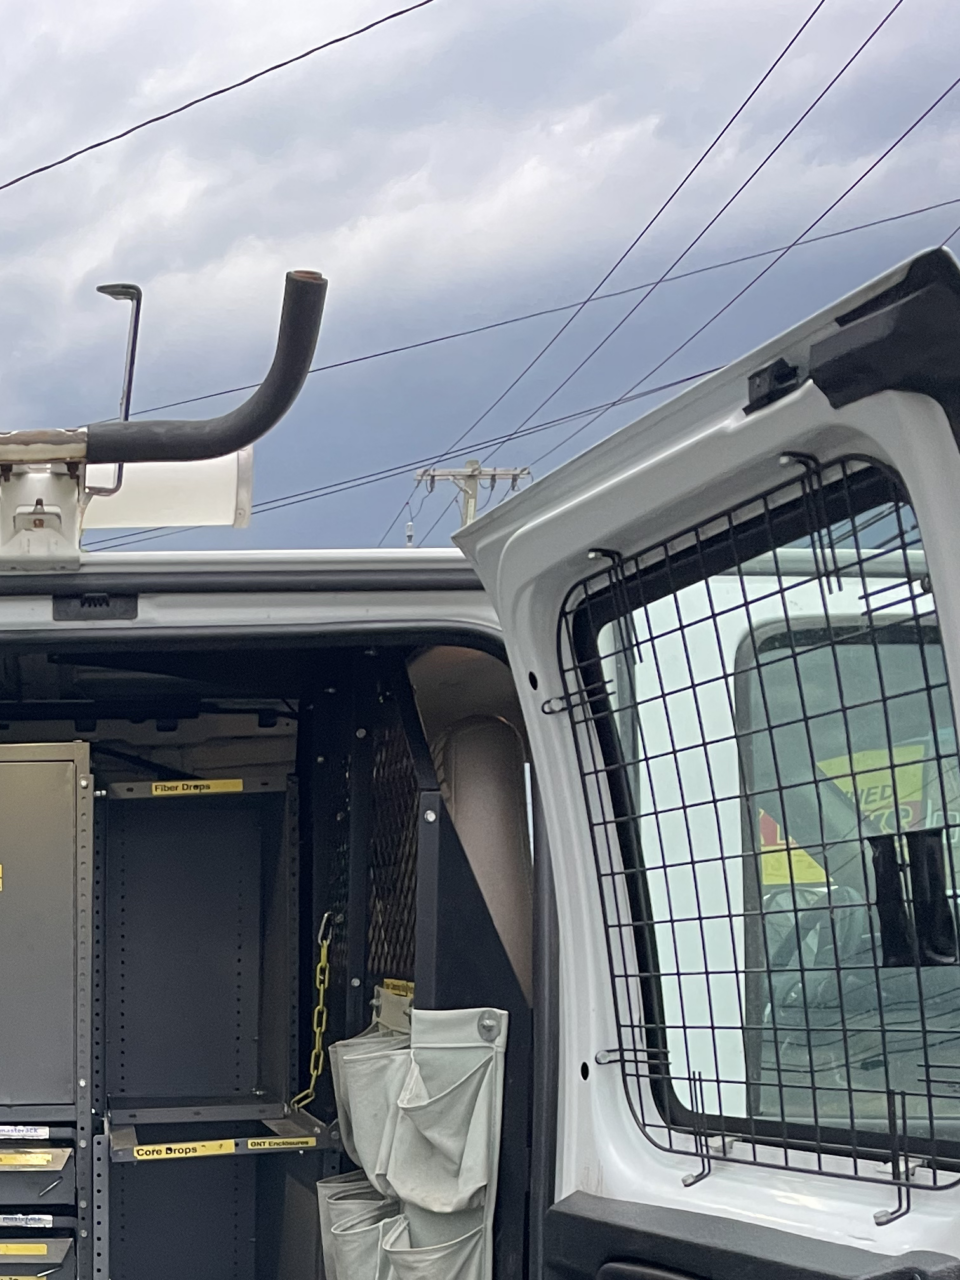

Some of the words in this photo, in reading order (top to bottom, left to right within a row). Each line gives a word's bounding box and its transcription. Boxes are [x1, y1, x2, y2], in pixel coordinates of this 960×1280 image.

[154, 784, 179, 793] Fiber
[181, 783, 211, 793] Drops
[136, 1148, 162, 1157] Core
[165, 1146, 198, 1155] Drops
